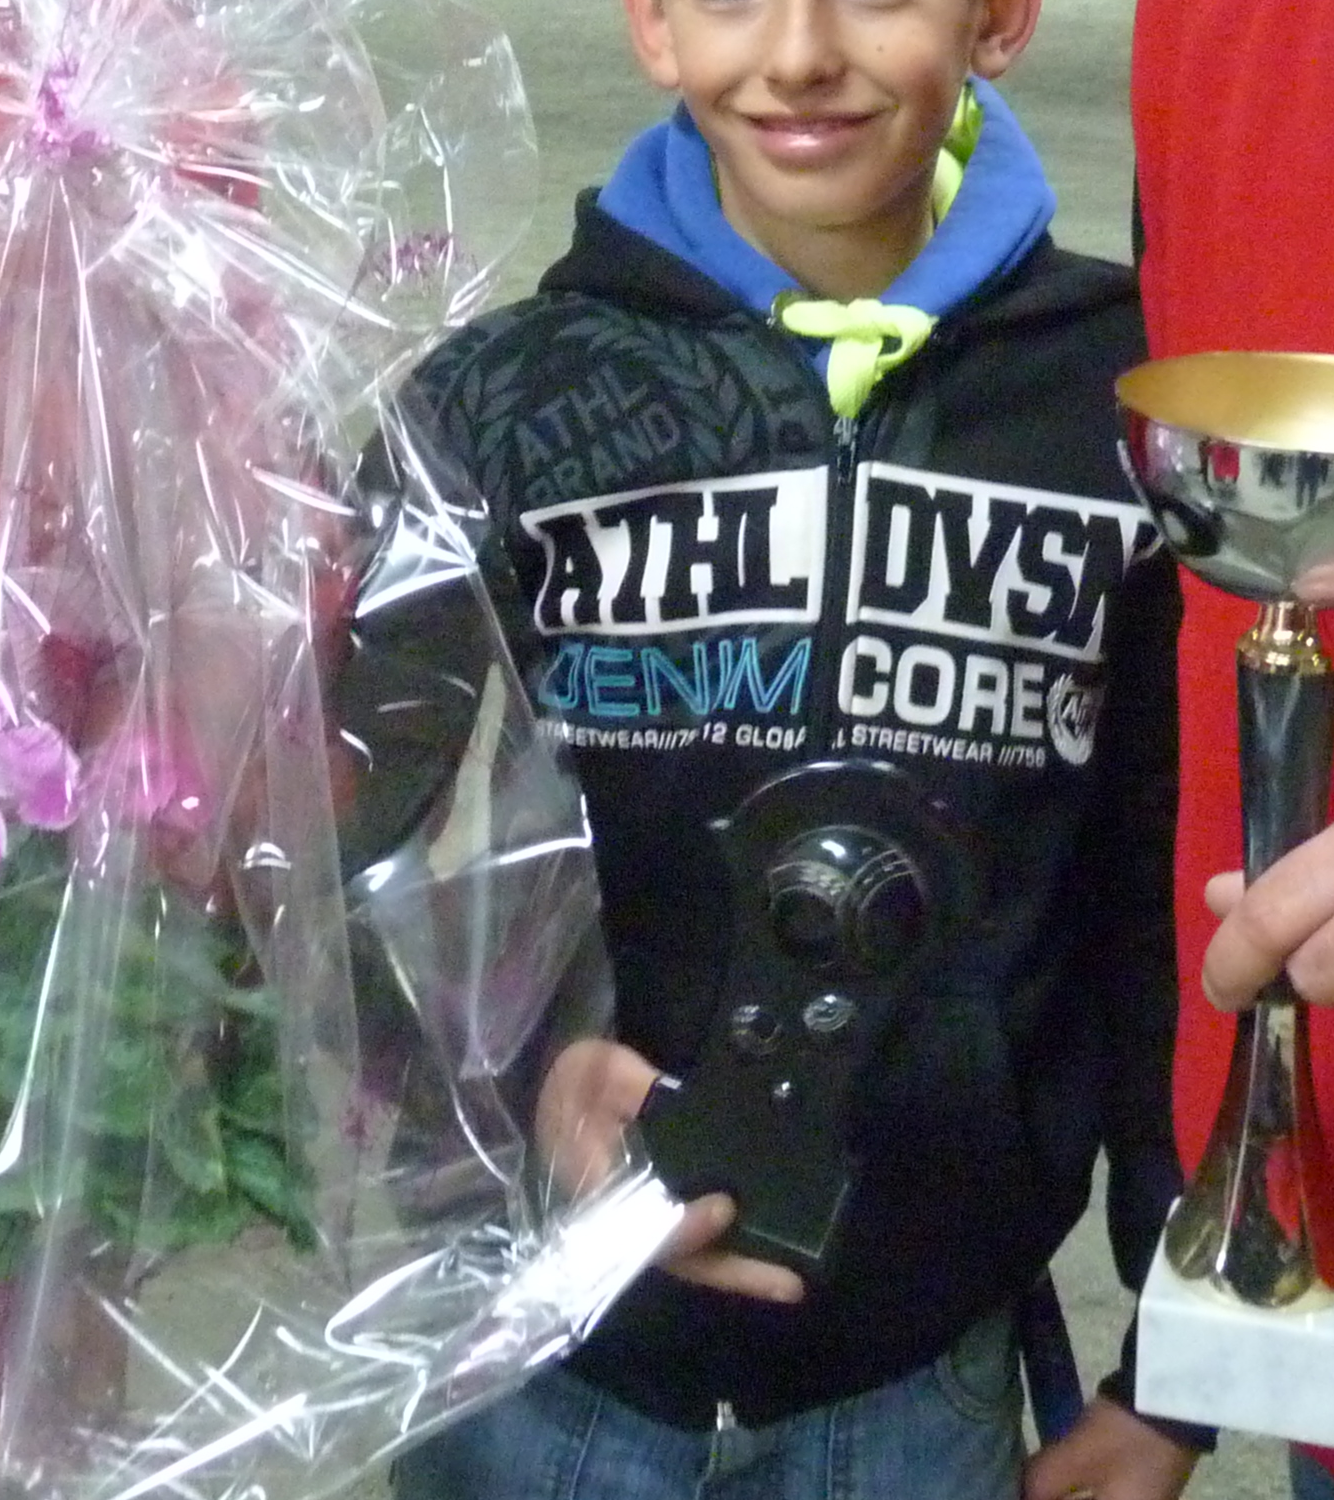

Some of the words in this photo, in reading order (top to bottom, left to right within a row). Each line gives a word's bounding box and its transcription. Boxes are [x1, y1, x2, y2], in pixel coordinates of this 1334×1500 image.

[515, 363, 651, 478] ATHL
[535, 486, 810, 625] ATHL
[538, 635, 812, 717] DENIM
[837, 634, 1045, 739] CORE
